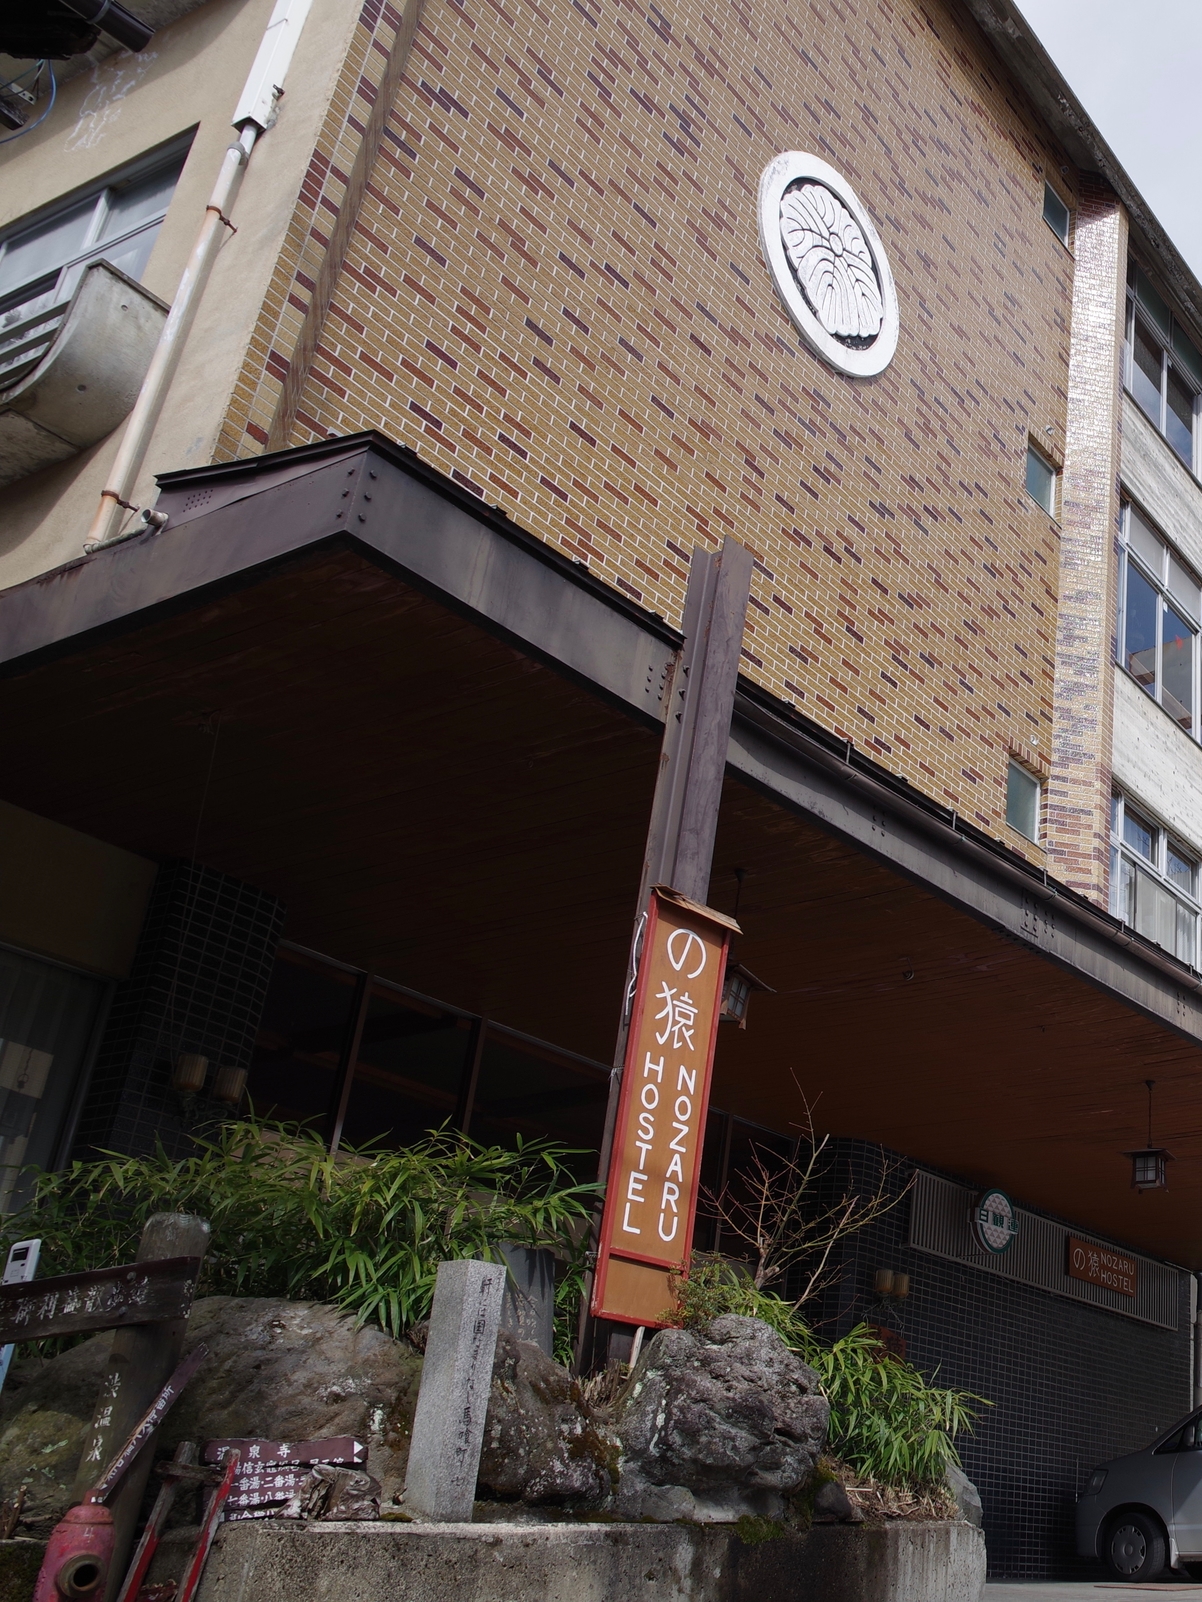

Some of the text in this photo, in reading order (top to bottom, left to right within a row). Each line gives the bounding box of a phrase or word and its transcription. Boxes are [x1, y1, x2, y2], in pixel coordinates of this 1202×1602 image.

[654, 928, 707, 1051] の猿
[622, 1051, 665, 1235] HOSTEL
[657, 1064, 697, 1242] NOZARU
[1073, 1248, 1100, 1278] の猿
[1100, 1252, 1134, 1276] NOZARU
[1100, 1269, 1134, 1293] HOSTEL
[85, 1372, 121, 1462] 渋温泉
